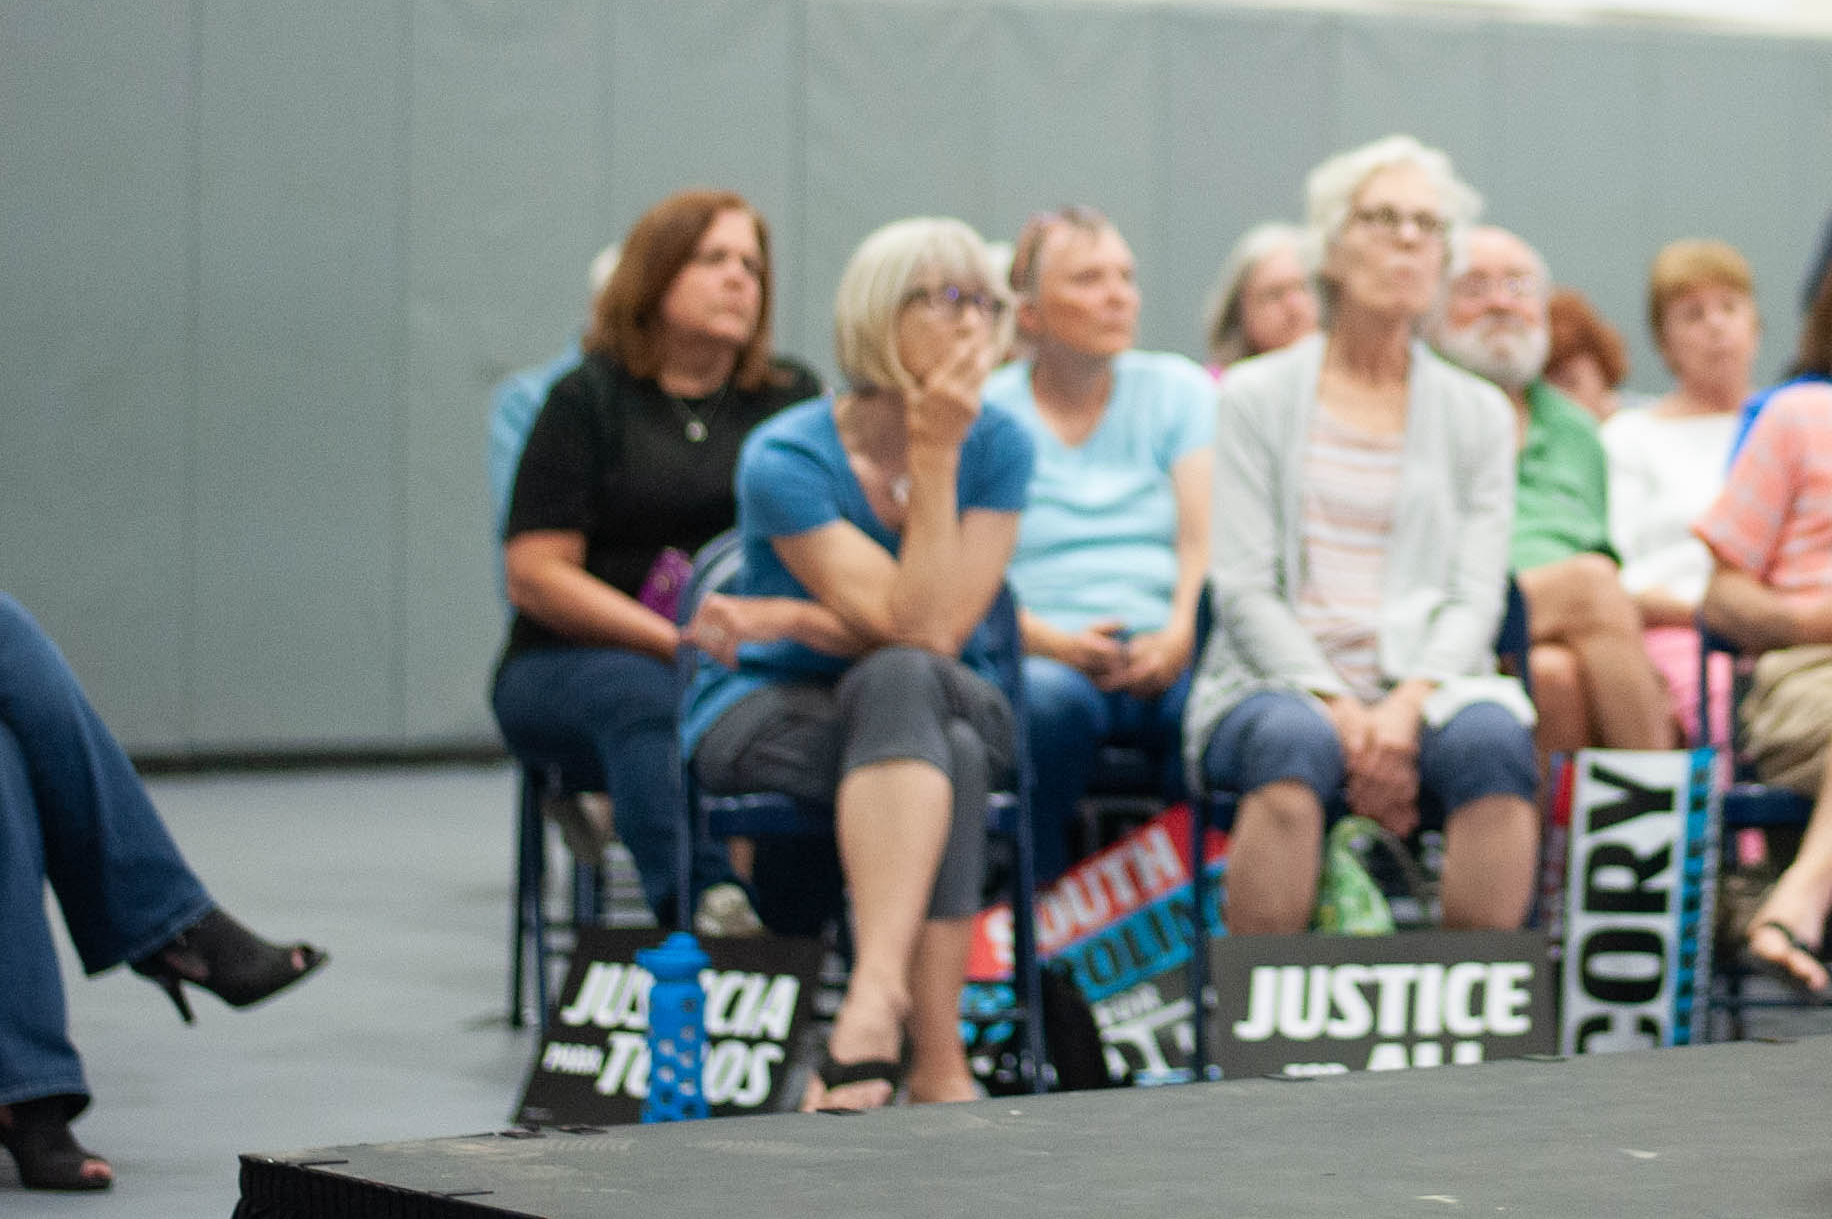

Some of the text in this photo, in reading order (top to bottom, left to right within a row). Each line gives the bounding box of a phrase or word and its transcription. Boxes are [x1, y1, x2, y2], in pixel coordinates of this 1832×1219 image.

[1575, 761, 1676, 1054] CORY
[558, 960, 800, 1043] JUSCIA
[1233, 961, 1537, 1042] JUSTICE
